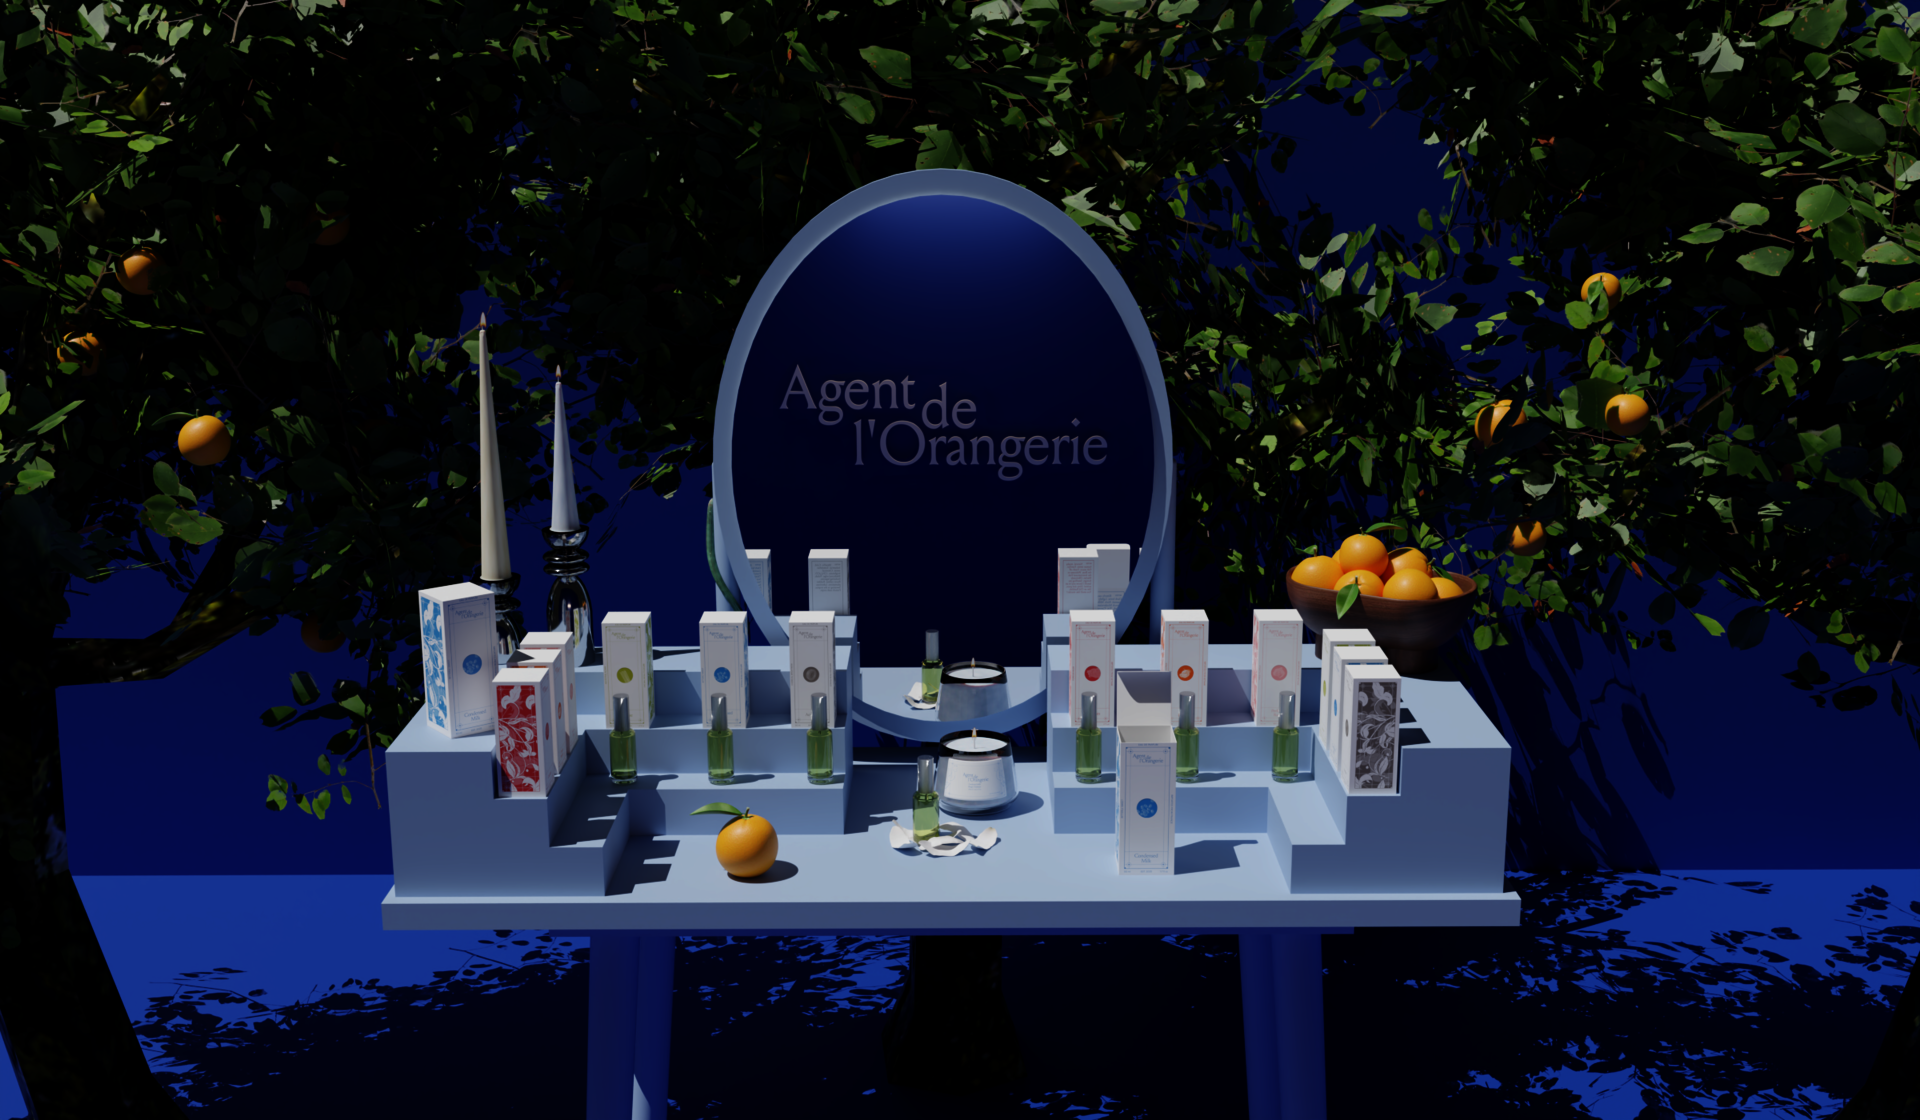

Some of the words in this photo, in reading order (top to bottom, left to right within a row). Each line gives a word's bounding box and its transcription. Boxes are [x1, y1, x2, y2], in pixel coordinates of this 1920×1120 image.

[779, 364, 916, 426] Agent
[921, 381, 977, 429] de
[853, 417, 1108, 481] l'Orangerie
